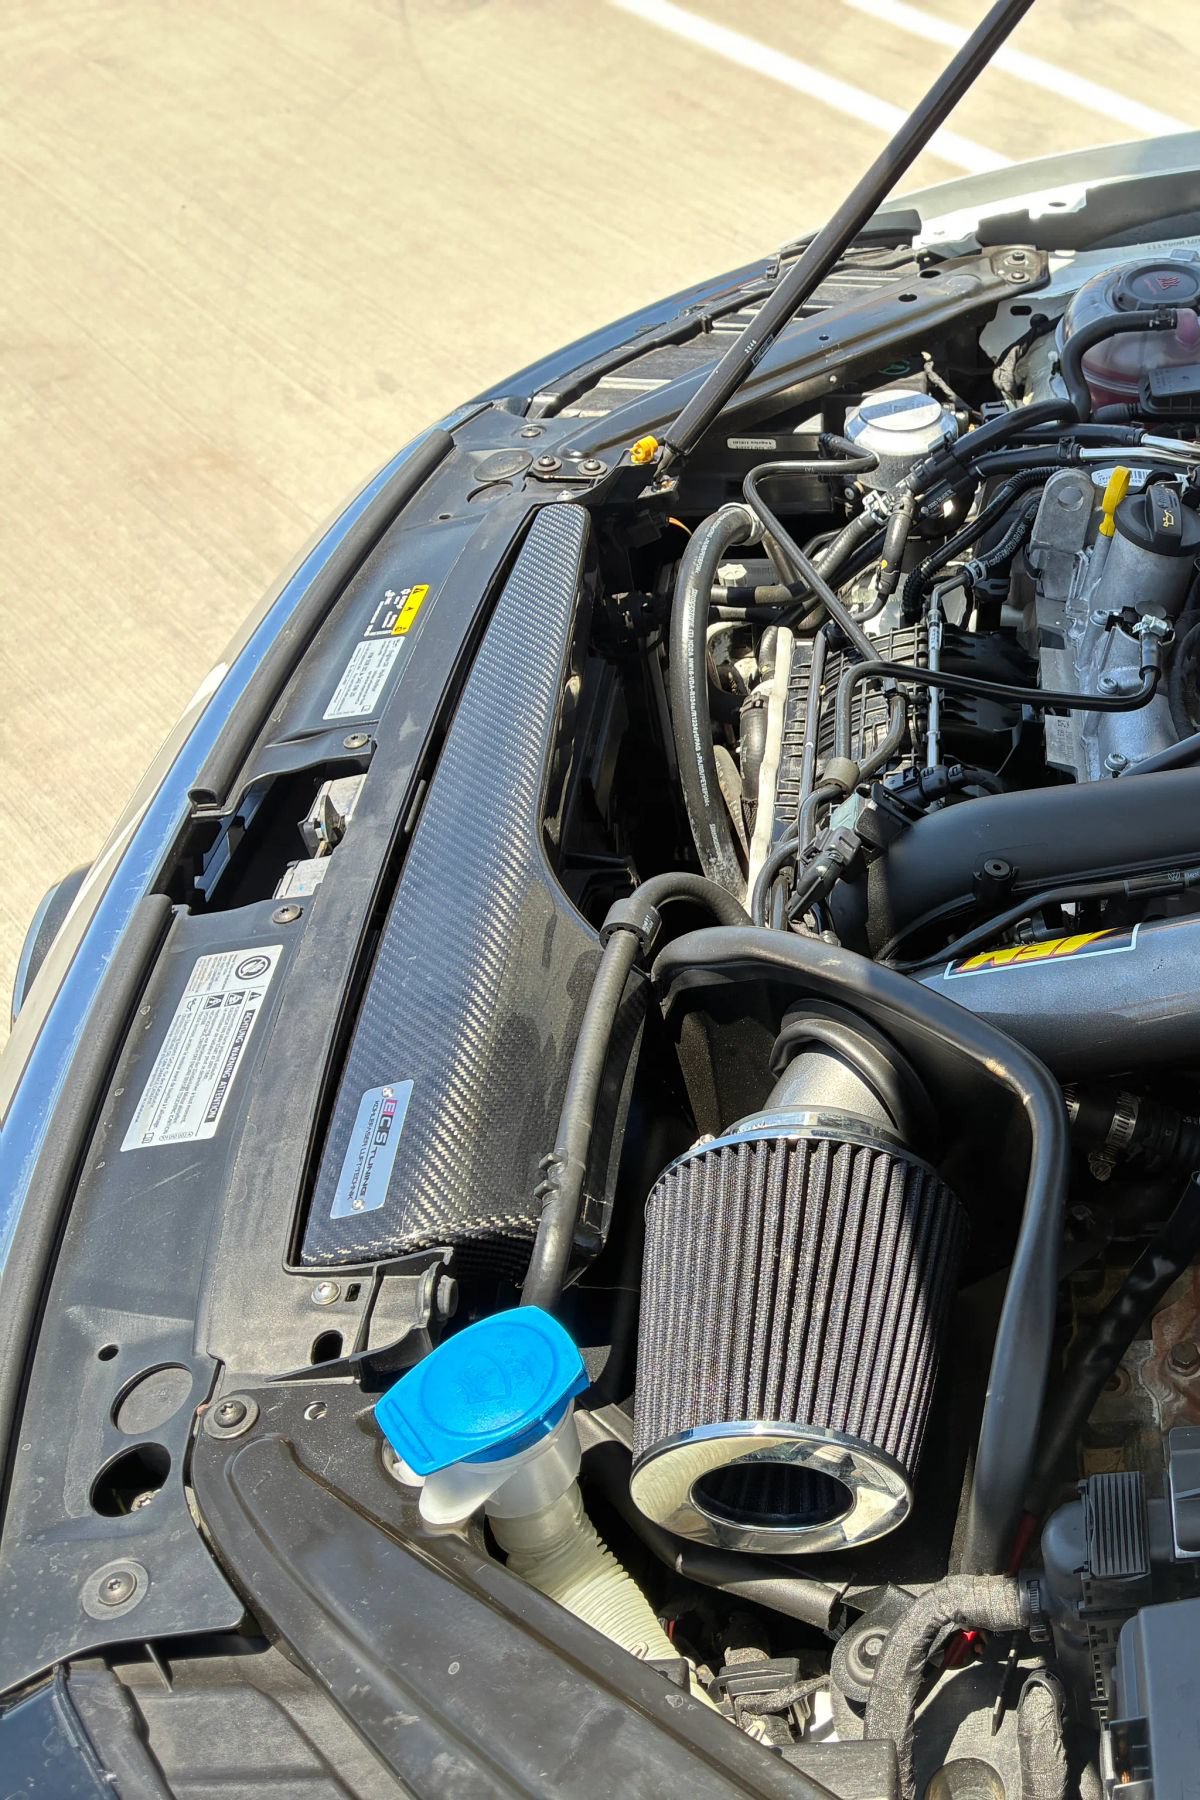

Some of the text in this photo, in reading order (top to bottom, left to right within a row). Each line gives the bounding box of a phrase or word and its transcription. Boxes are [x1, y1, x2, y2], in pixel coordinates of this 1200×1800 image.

[207, 1011, 252, 1118] ACHTUNG WARNING ATTENTION
[358, 1097, 398, 1196] ECS TUNING
